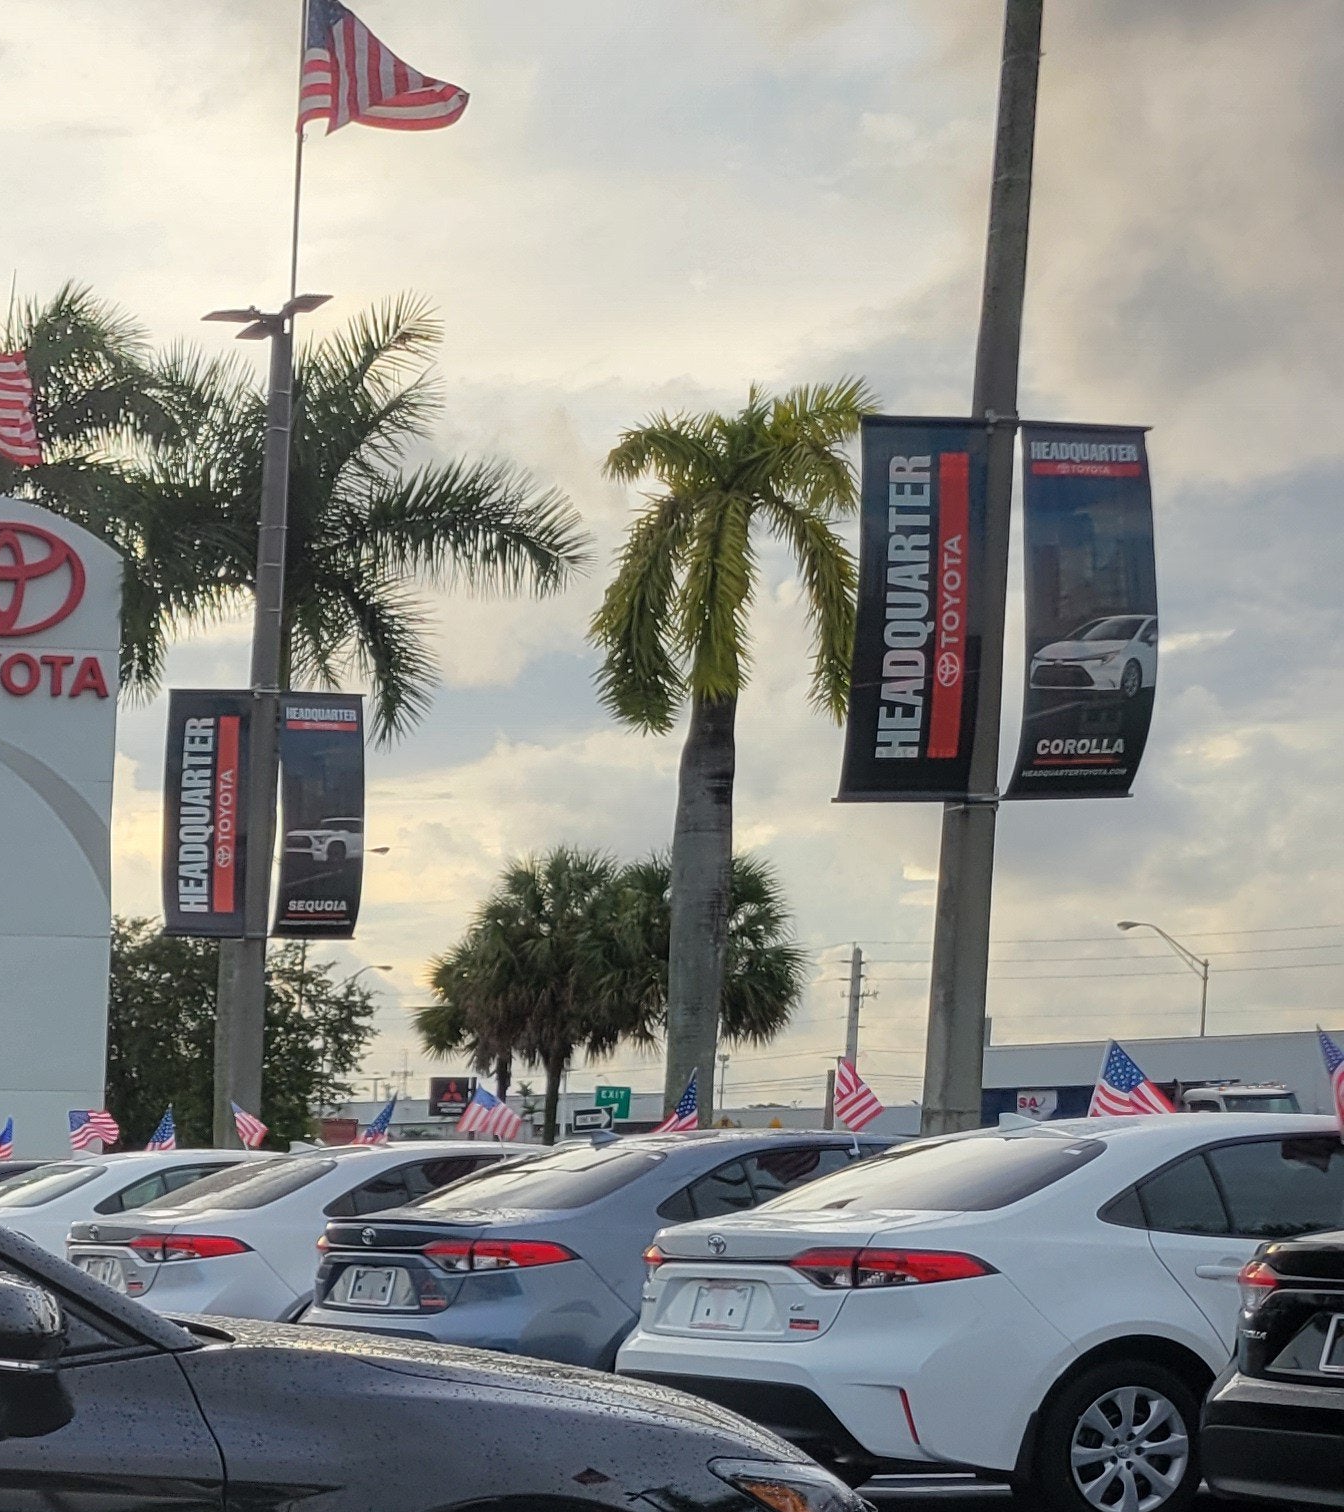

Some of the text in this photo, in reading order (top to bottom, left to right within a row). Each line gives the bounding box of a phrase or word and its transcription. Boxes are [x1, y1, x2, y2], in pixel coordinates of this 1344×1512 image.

[1031, 441, 1138, 463] HEADQUARTER
[1071, 464, 1111, 475] TOYOTA
[940, 534, 964, 648] TOYOTA
[874, 454, 935, 759] HEADQUARTER
[286, 706, 357, 722] HEADQUARTER
[1036, 738, 1125, 756] COROLLA
[179, 717, 215, 913] HEADQUARTER
[217, 769, 234, 845] TOYOTA
[287, 899, 347, 912] SEQUOIA
[600, 1089, 626, 1100] EXIT
